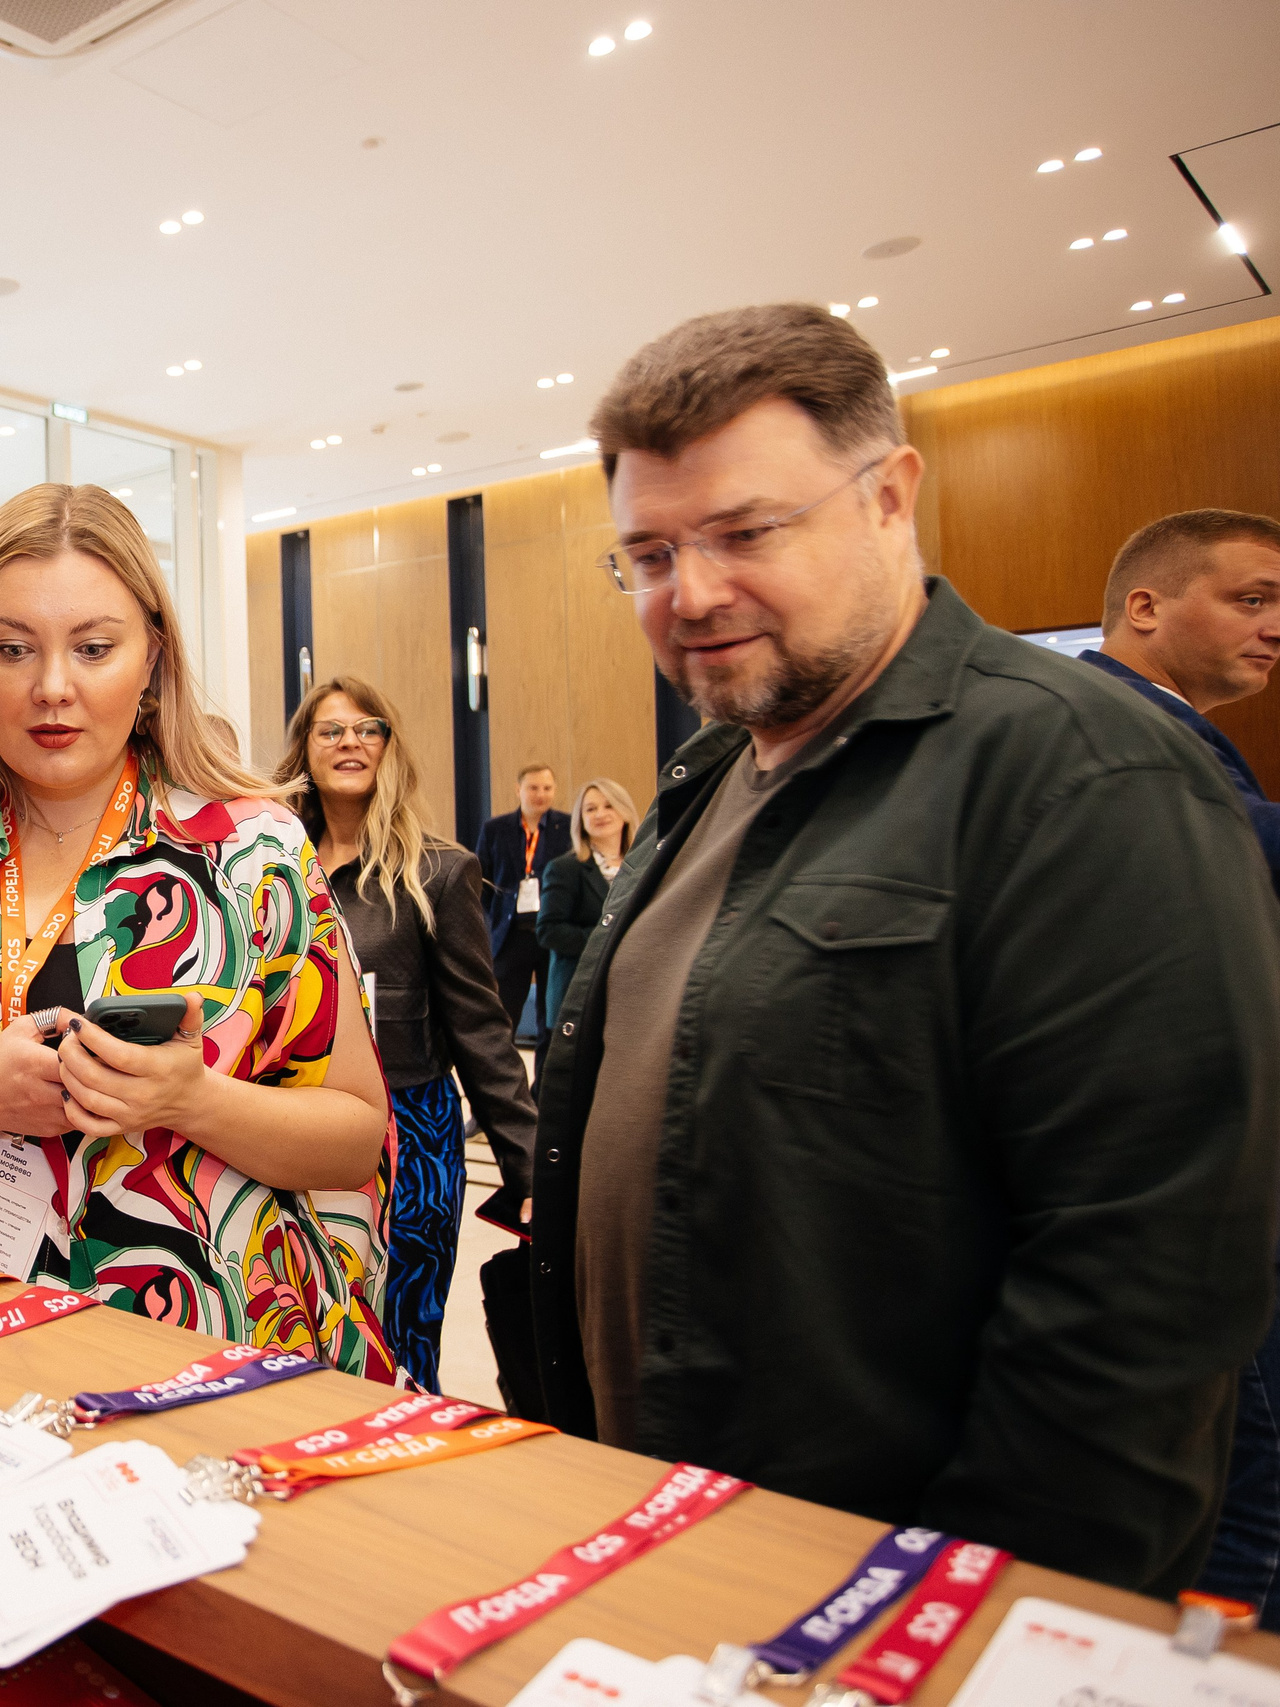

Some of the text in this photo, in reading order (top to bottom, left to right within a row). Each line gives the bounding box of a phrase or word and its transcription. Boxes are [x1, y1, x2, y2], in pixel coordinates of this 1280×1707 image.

[5, 857, 19, 917] IT-СРЕДА
[8, 780, 134, 1022] OCS OCS IT-СРЕД
[8, 937, 21, 972] OCS
[1, 1149, 28, 1166] Полина
[42, 1294, 81, 1314] OCS
[222, 1344, 262, 1361] OCS
[133, 1354, 309, 1404] IT-СРЕДА OCS
[294, 1430, 349, 1453] OCS
[323, 1435, 448, 1468] IT-СРЕДА
[470, 1419, 523, 1440] OCS
[449, 1573, 570, 1634] IT-СРЕДА
[572, 1533, 627, 1563] OCS
